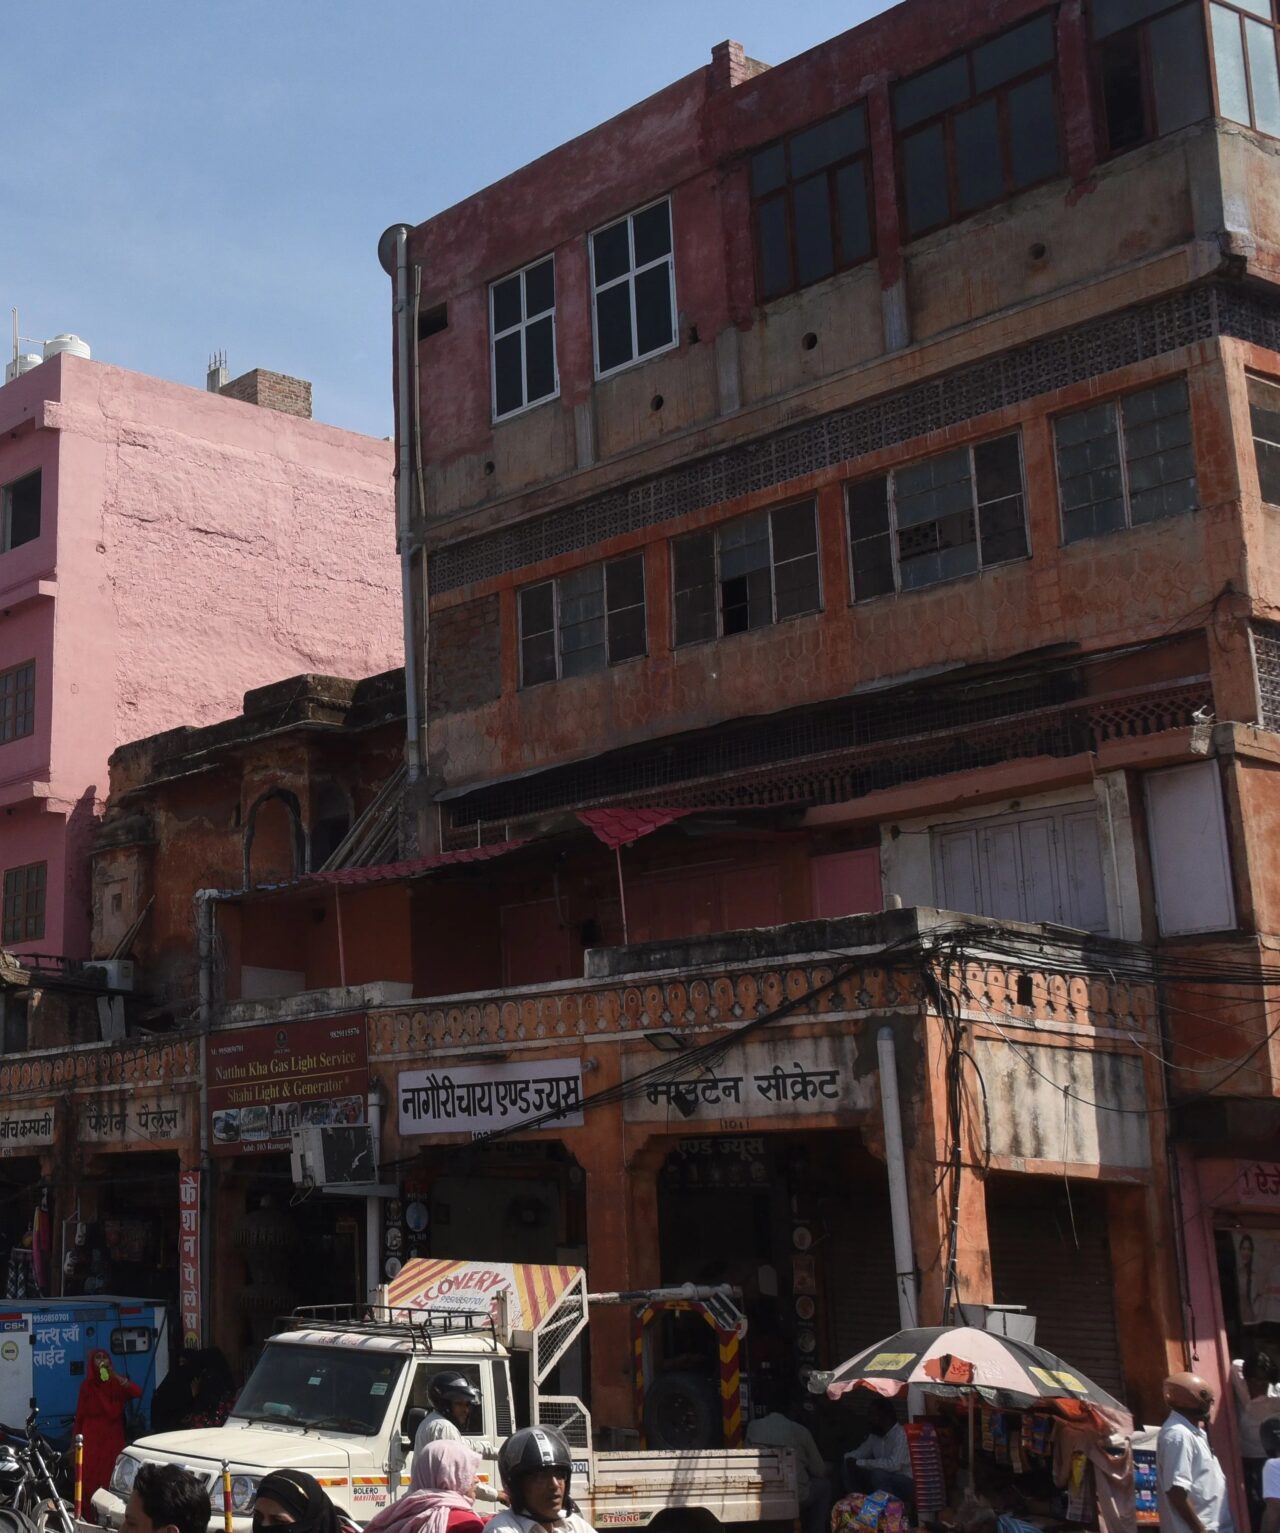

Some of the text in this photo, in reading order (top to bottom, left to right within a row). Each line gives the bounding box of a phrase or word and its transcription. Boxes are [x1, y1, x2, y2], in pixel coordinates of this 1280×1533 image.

[215, 1049, 357, 1081] Natthu Kha Gas Light Service
[227, 1077, 344, 1103] Shahi Light & Generator
[753, 1061, 840, 1102] सीक्रेट
[401, 1072, 580, 1121] नागौरी चाय एण्ड ज्यूस
[135, 1103, 179, 1131] पैलेस
[353, 1487, 379, 1495] BOLERO
[603, 1513, 640, 1523] STRONG
